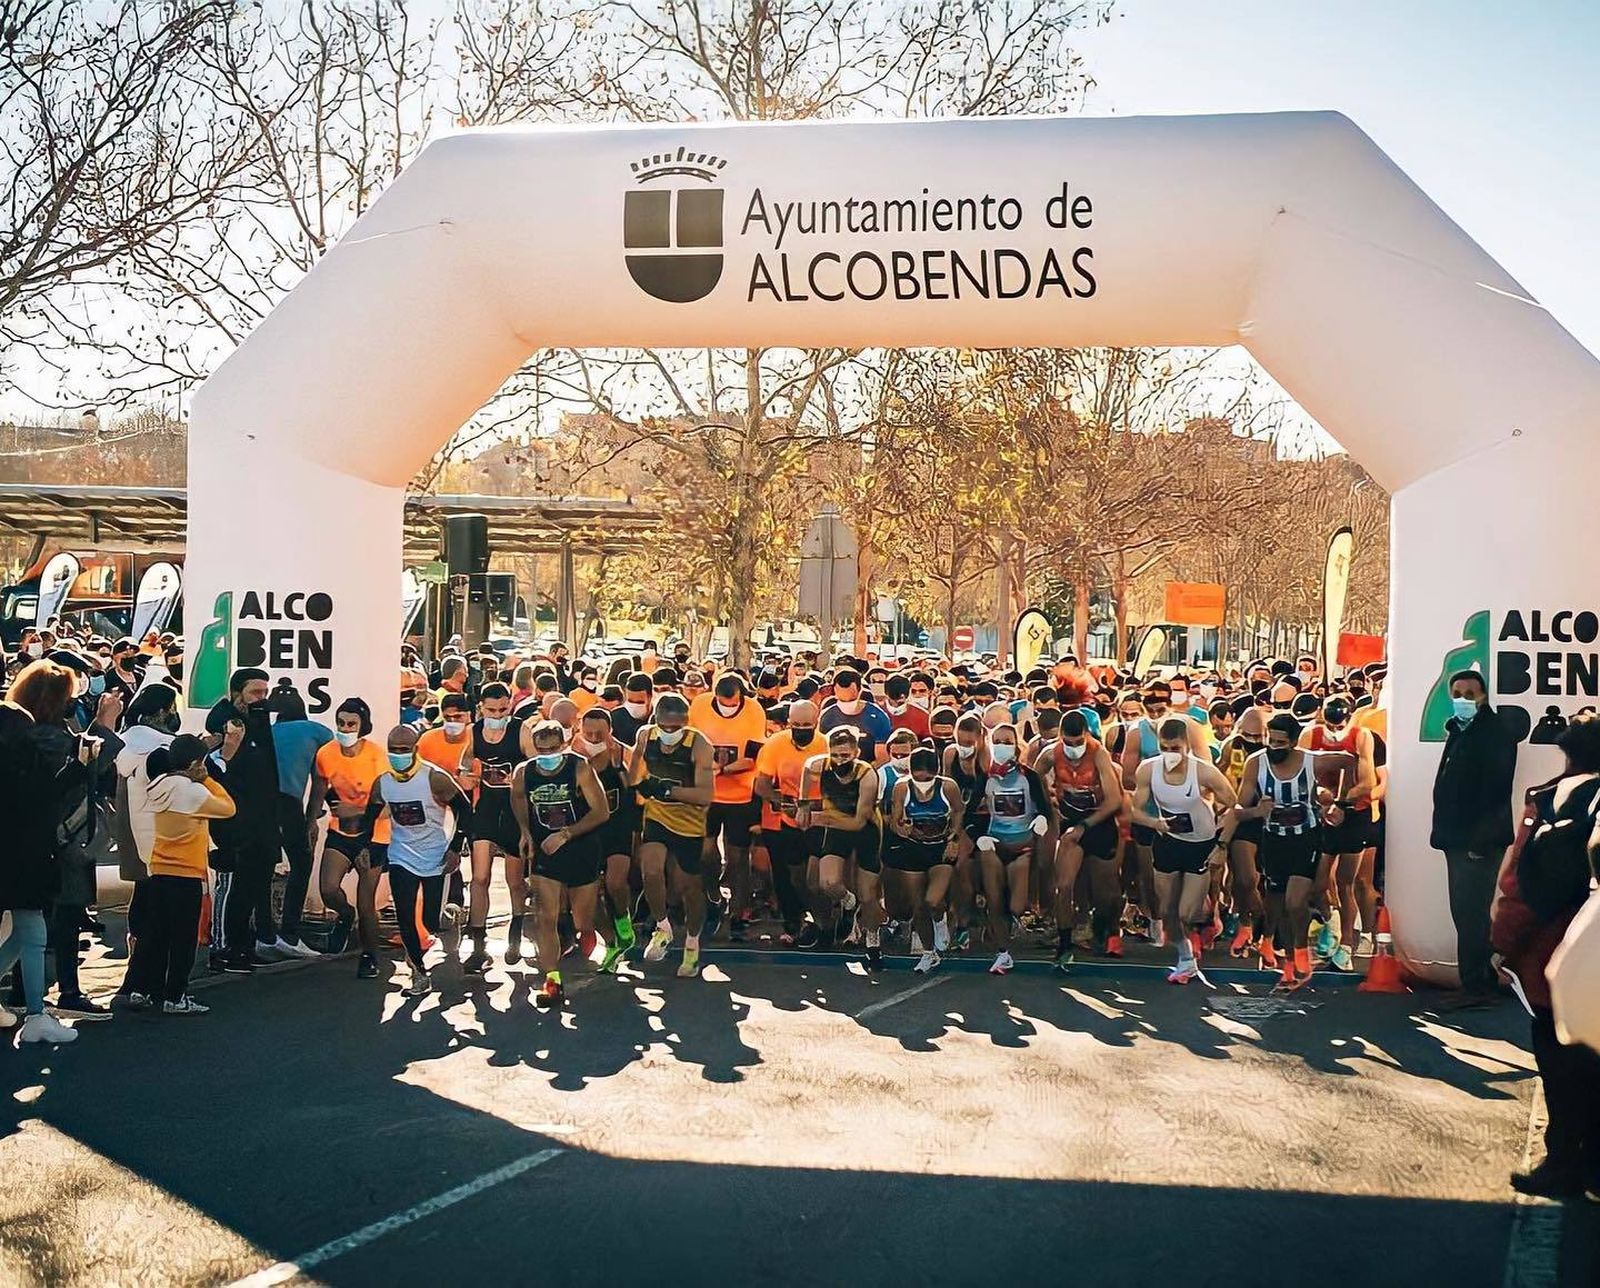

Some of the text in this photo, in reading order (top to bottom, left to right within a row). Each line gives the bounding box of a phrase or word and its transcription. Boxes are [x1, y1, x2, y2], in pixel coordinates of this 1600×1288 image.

[740, 182, 1094, 250] Ayuntamiento de
[747, 247, 1097, 302] ALCOBENDAS
[239, 590, 334, 622] ALCO
[1498, 609, 1599, 644] ALCO
[236, 628, 333, 670] BEN
[1497, 651, 1599, 697] BEN
